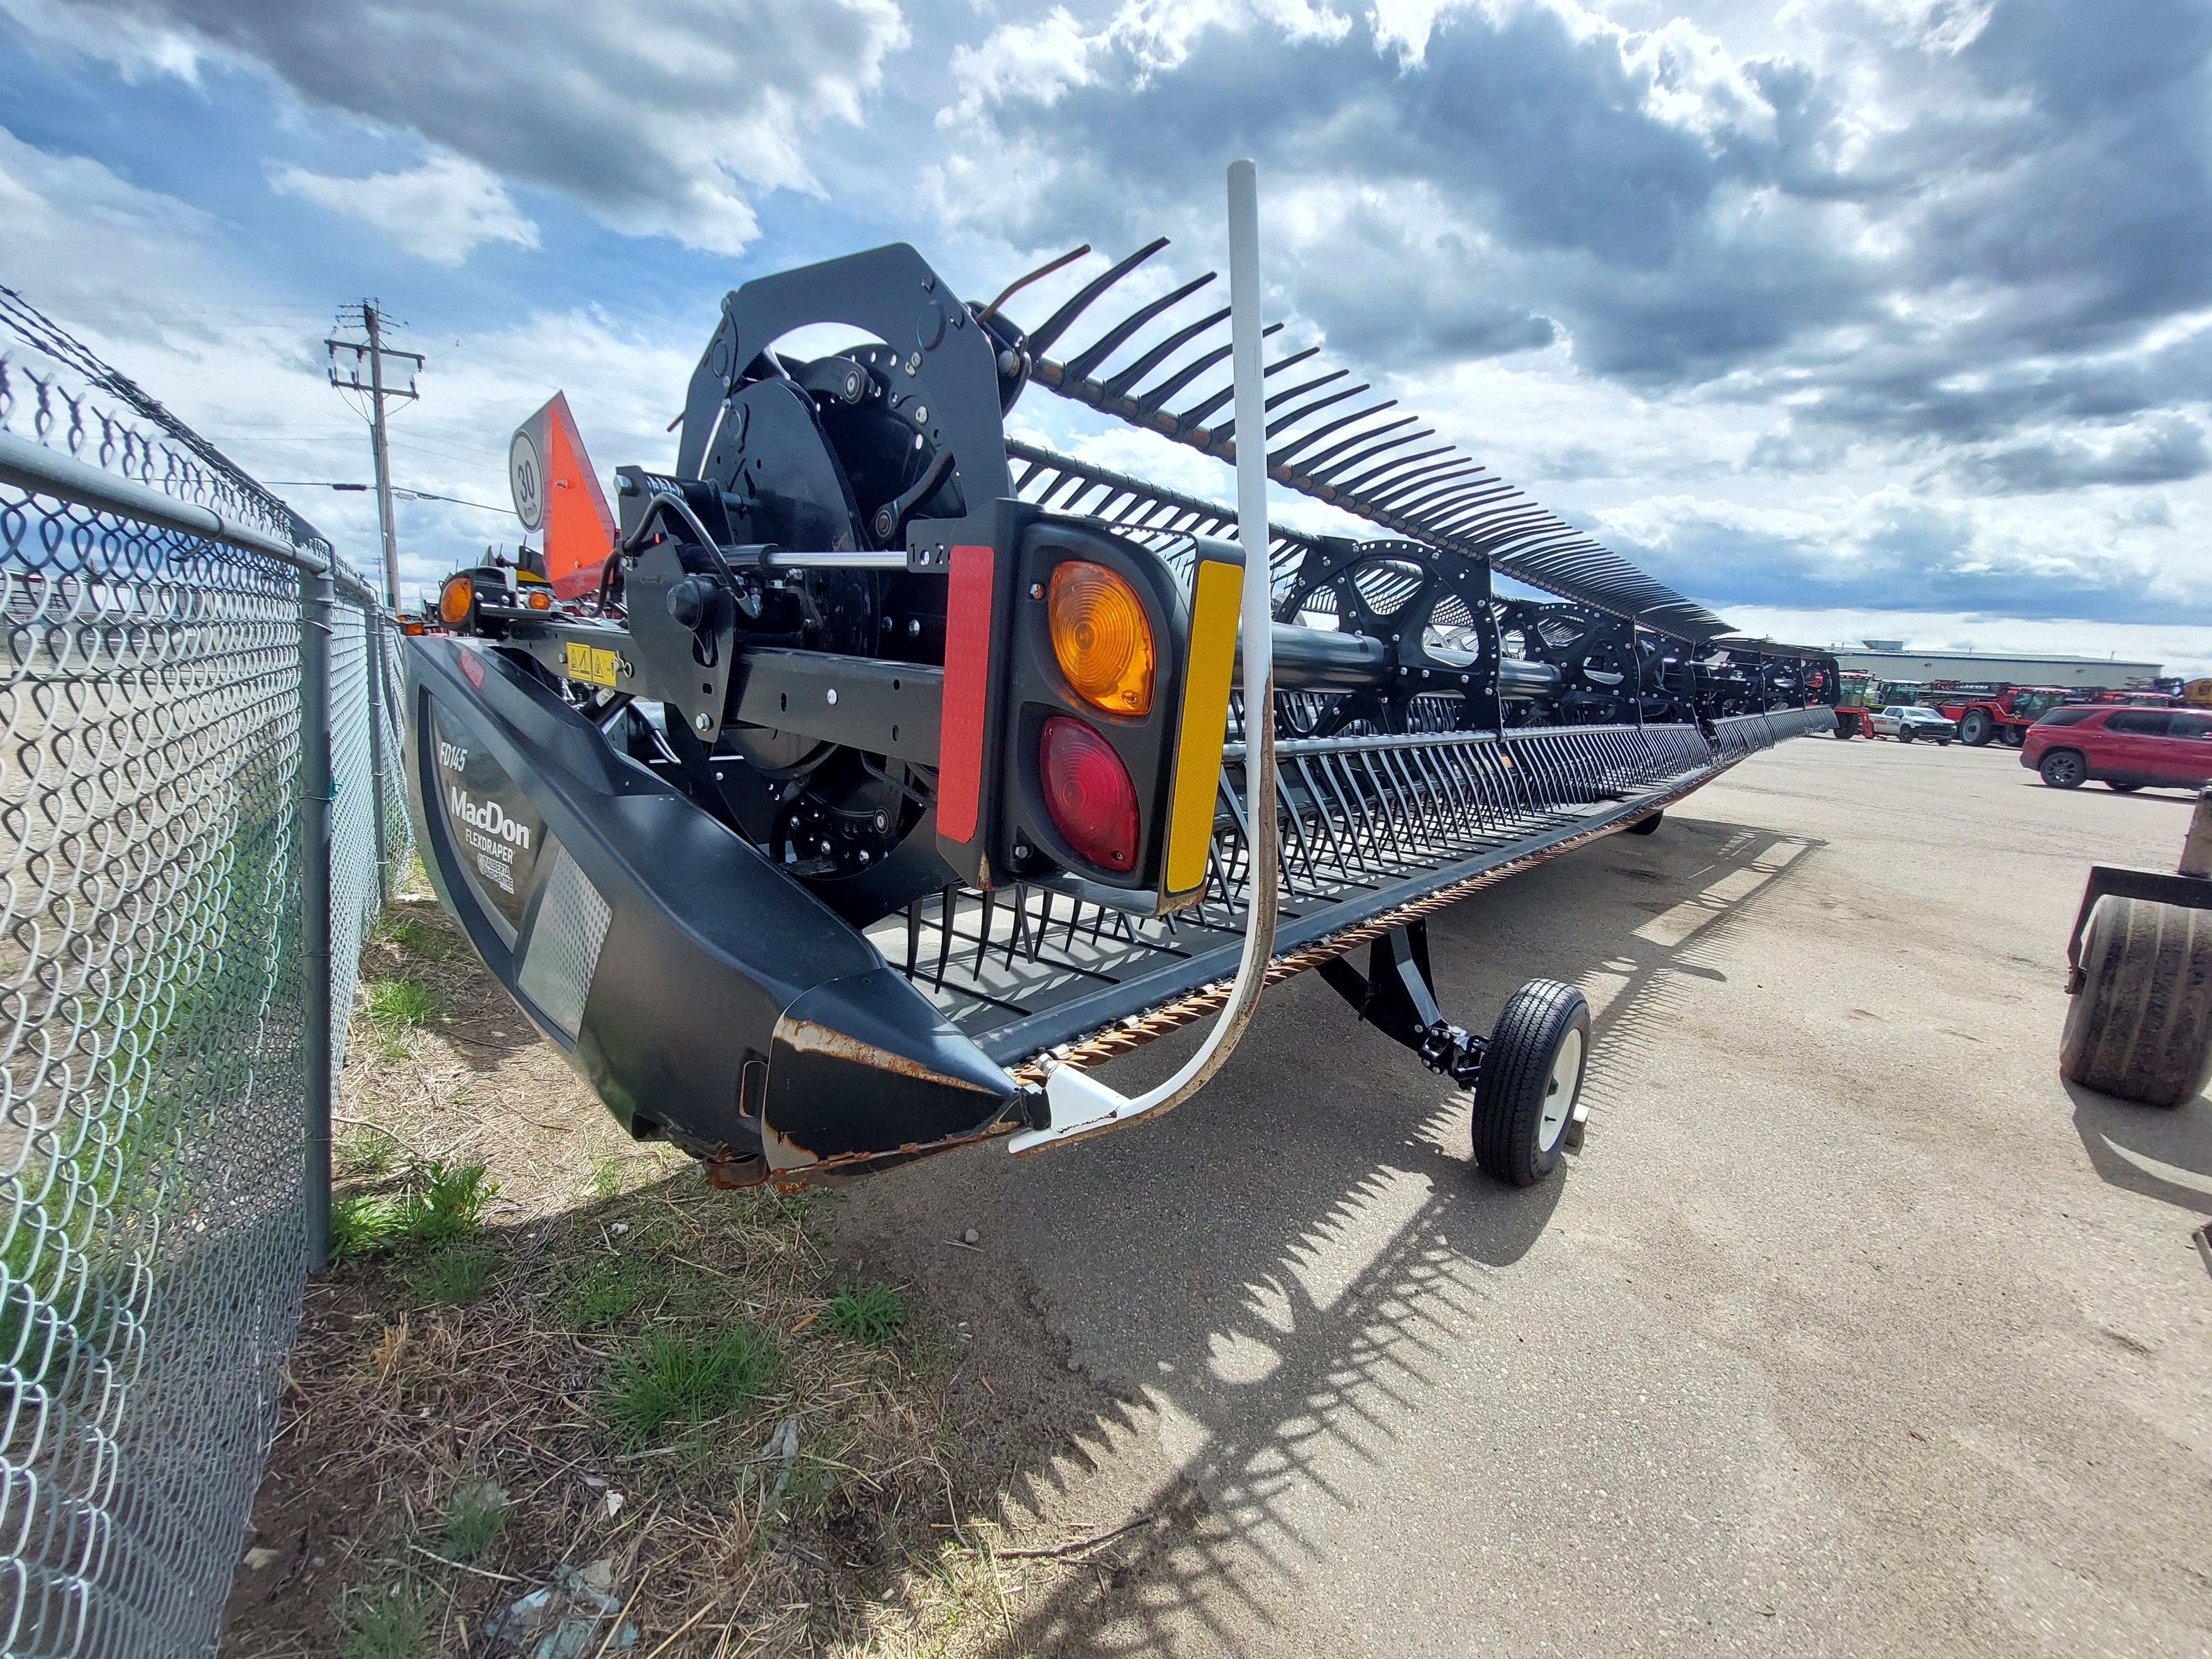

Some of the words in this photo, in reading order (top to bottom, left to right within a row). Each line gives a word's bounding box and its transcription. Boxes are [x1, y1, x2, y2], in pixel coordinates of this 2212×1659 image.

[518, 460, 535, 503] 30
[524, 500, 538, 519] km/h
[910, 542, 916, 563] 1
[935, 542, 944, 565] 2
[440, 742, 468, 772] FD145
[452, 786, 529, 849] MacDon
[466, 828, 513, 864] FLEXDRAPER
[486, 858, 510, 878] ALBERTA
[494, 872, 513, 889] CENTRE
